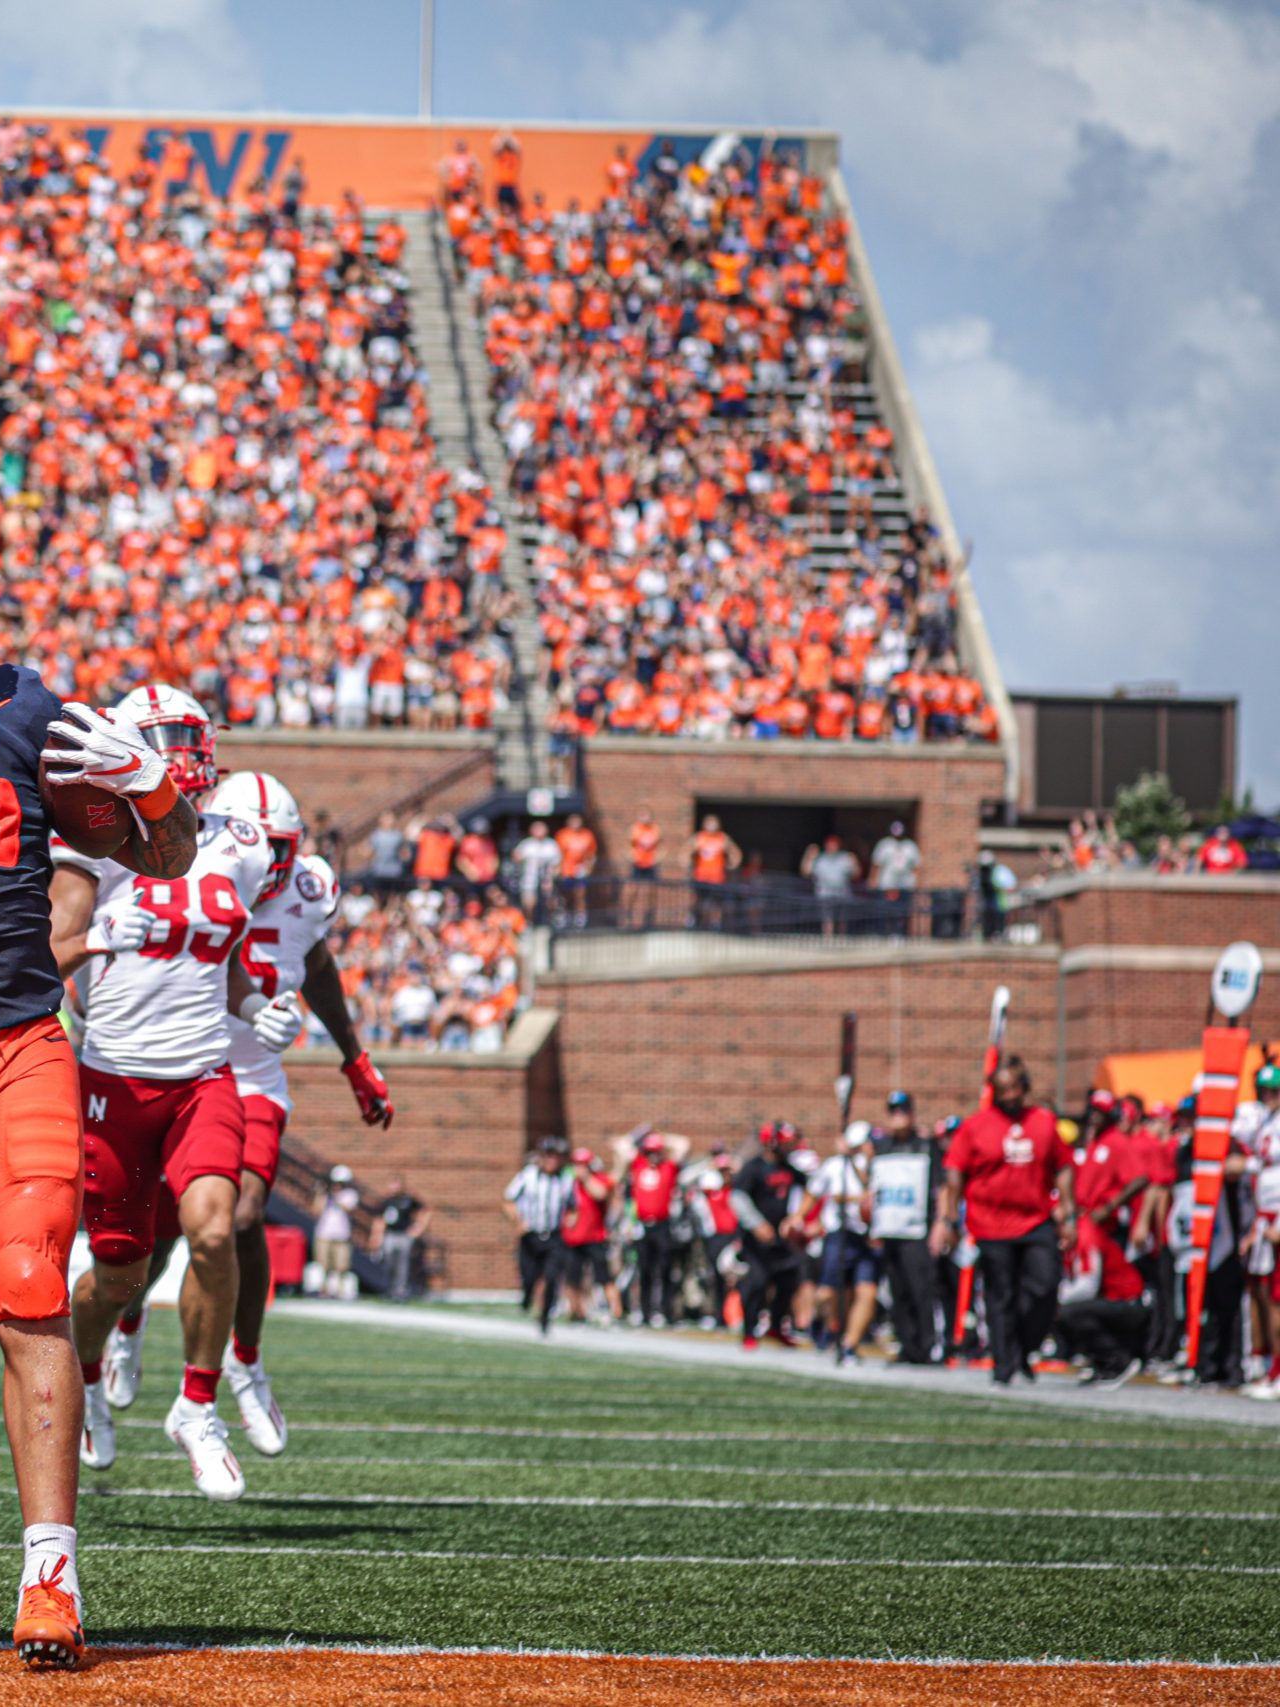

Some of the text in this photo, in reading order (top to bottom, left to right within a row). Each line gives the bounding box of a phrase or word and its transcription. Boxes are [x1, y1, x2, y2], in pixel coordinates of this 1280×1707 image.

[86, 801, 117, 829] N
[133, 872, 247, 965] 89
[87, 1093, 108, 1121] N
